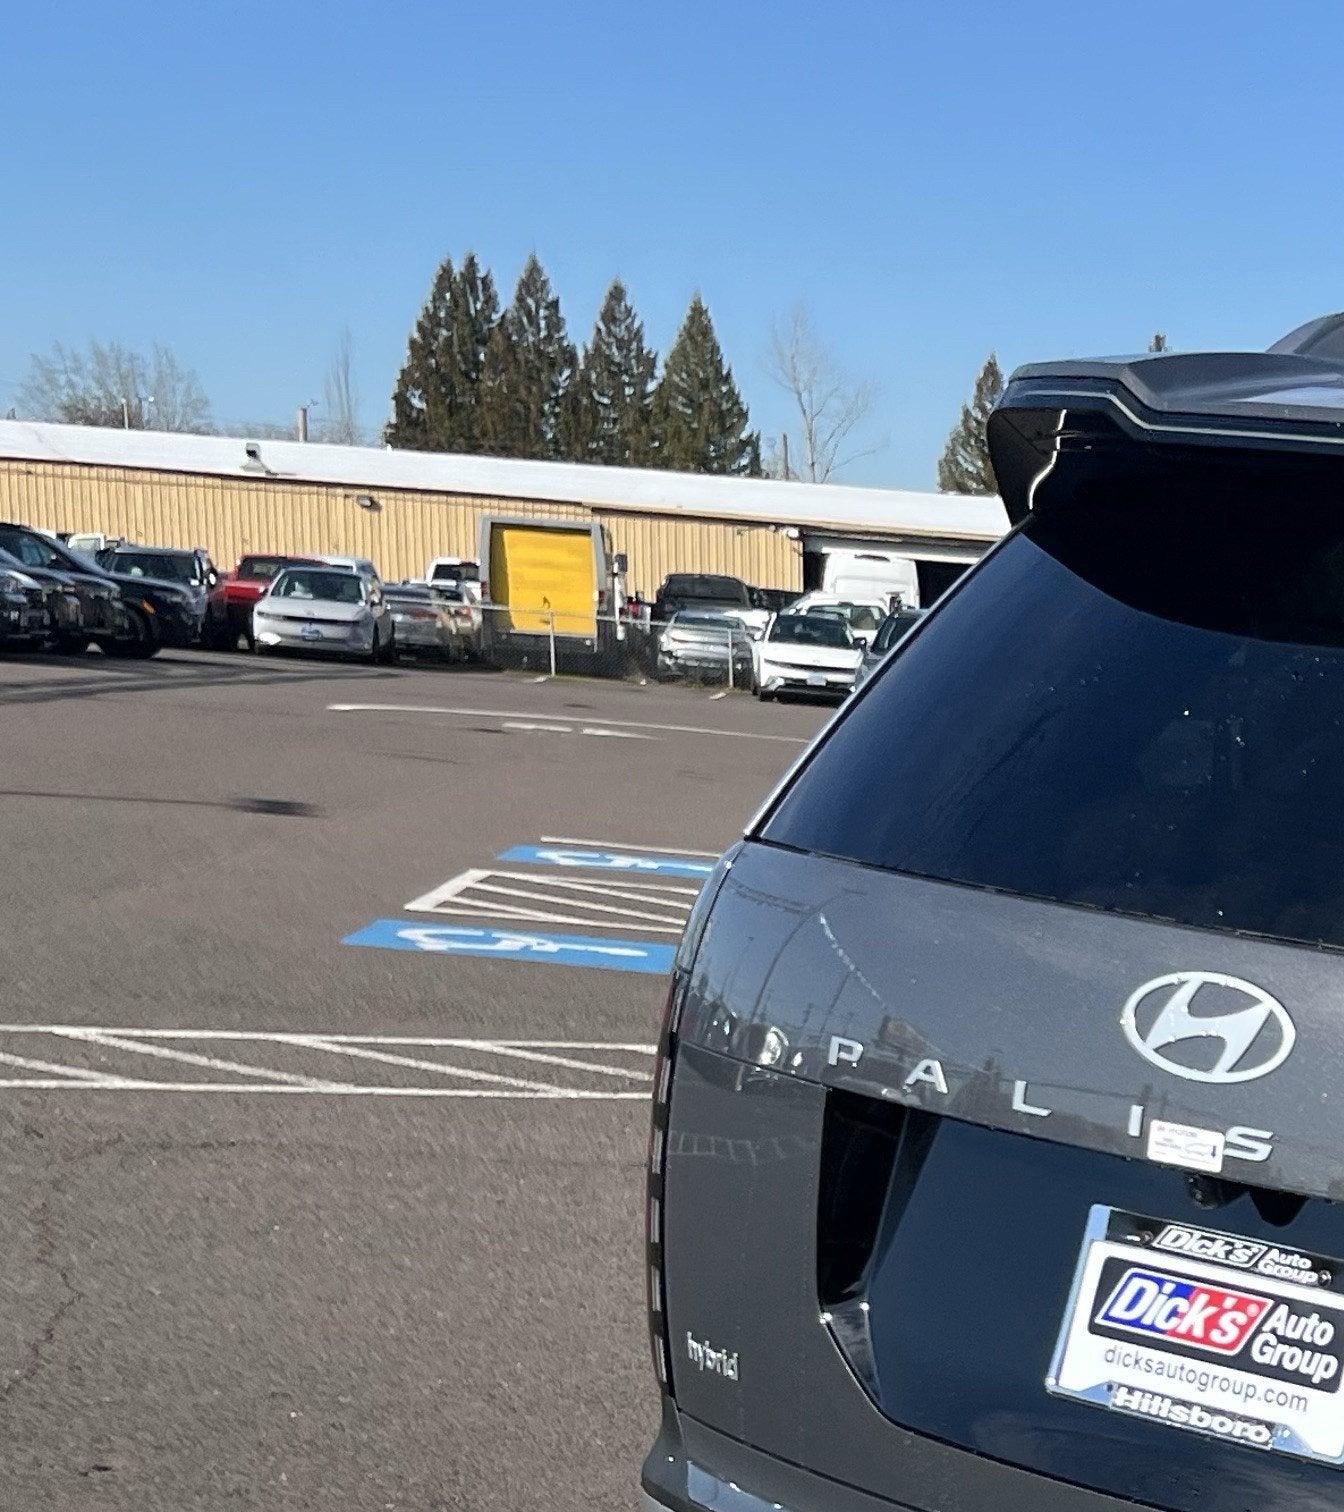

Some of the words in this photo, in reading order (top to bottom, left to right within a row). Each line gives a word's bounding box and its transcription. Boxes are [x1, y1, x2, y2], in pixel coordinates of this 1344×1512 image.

[1257, 1258, 1319, 1284] Group
[1268, 1249, 1312, 1269] Auto
[1110, 1276, 1247, 1345] Dick's
[1263, 1304, 1335, 1346] Auto
[686, 1331, 739, 1381] hybrid
[1104, 1345, 1309, 1413] dicksautogroup.com
[1251, 1332, 1339, 1385] Group
[1112, 1386, 1273, 1444] Hillsboro
